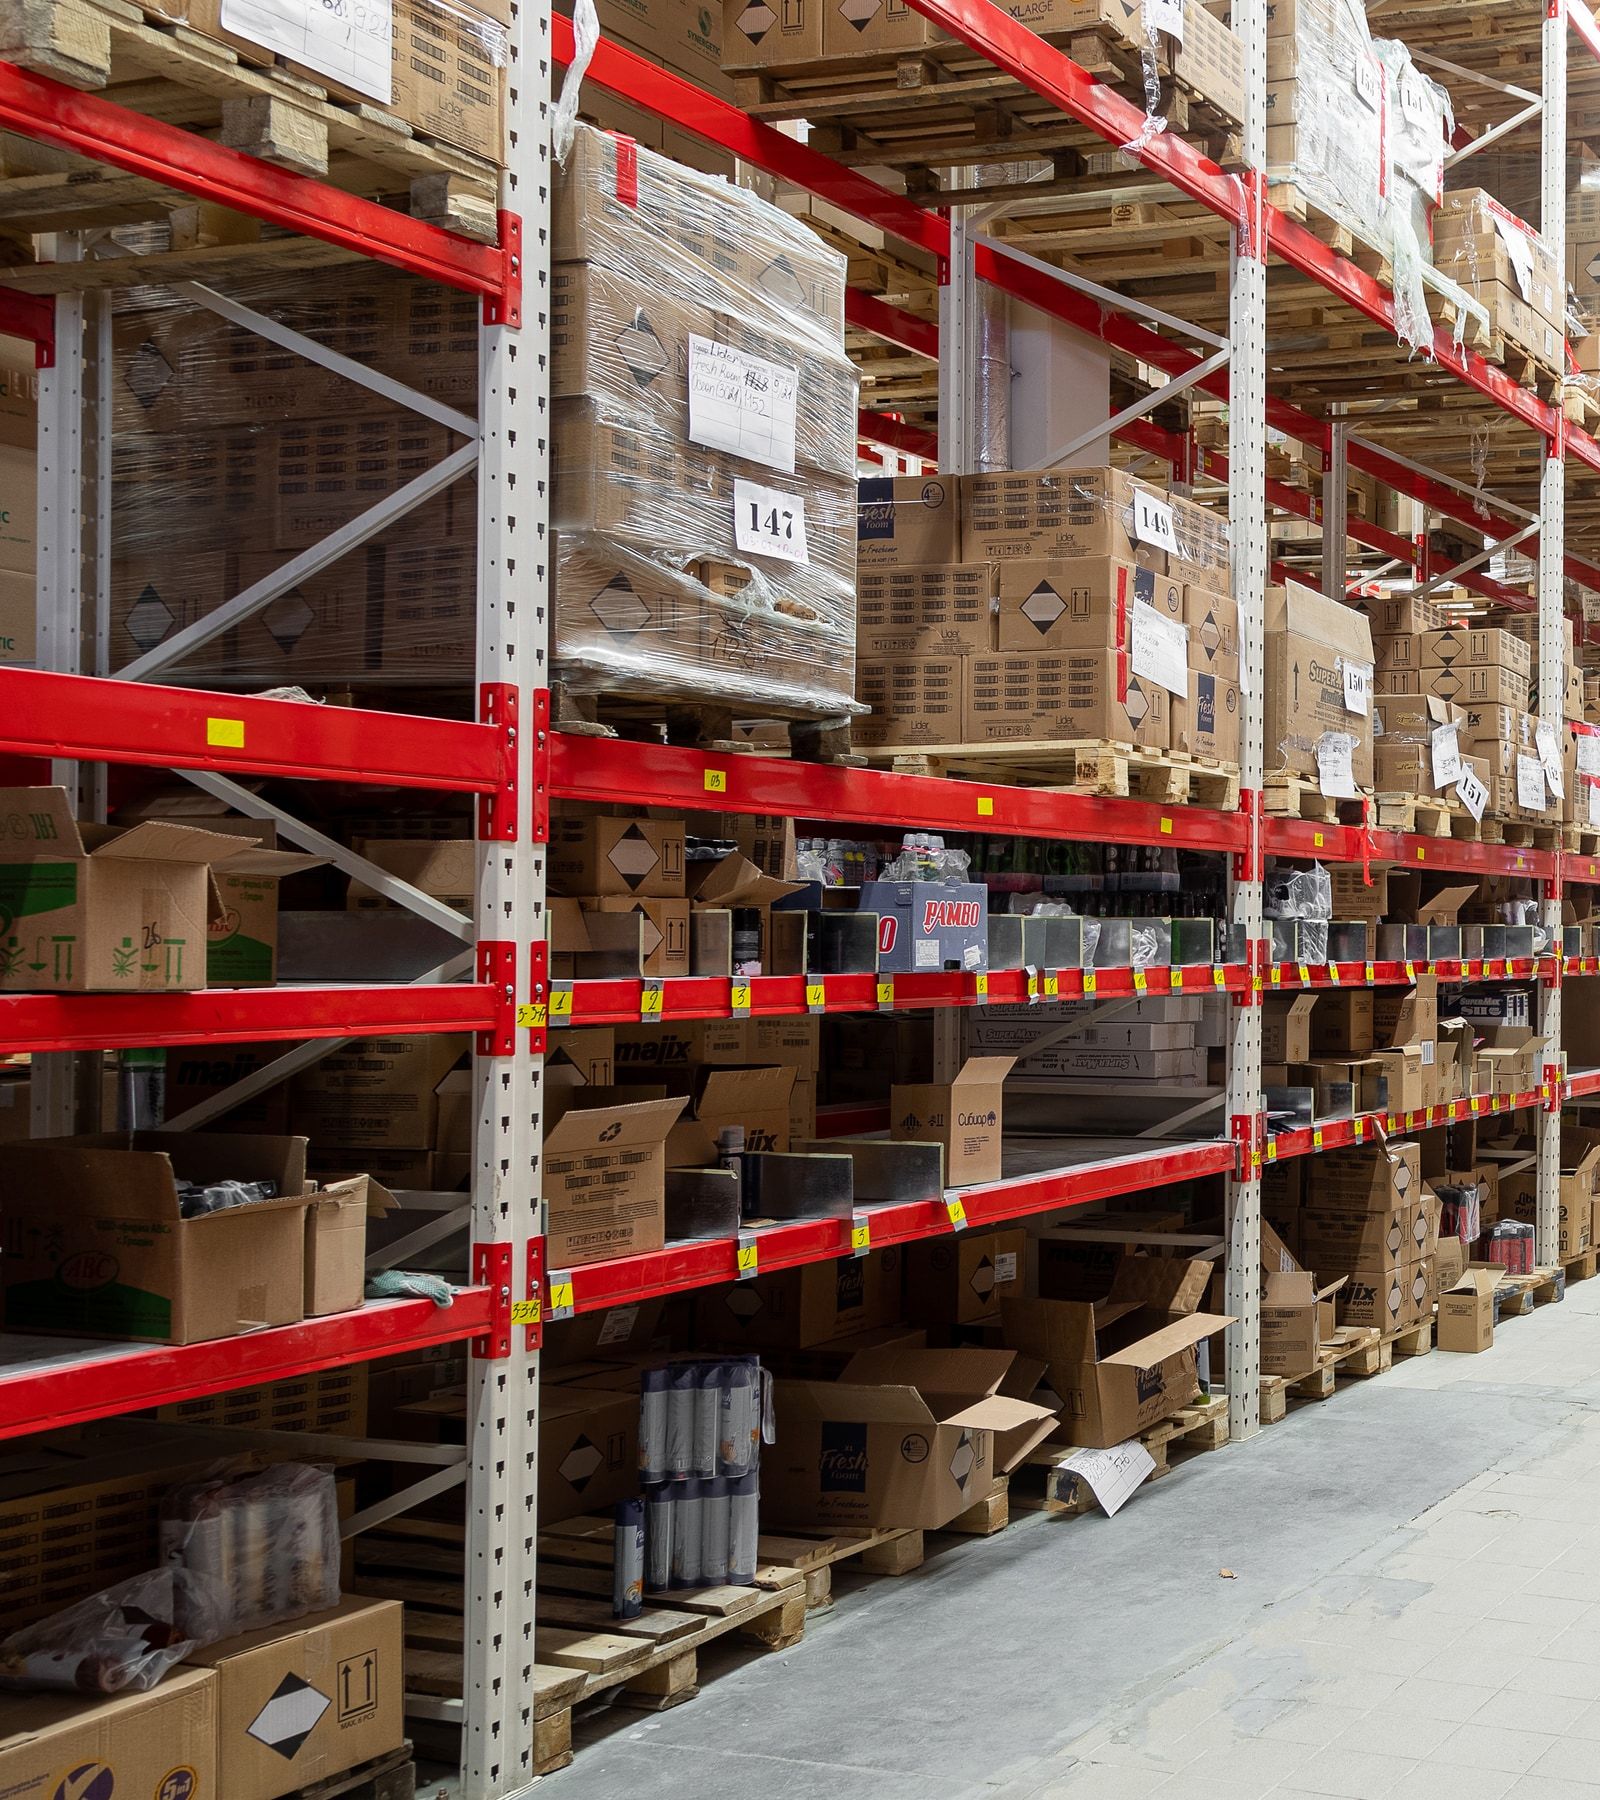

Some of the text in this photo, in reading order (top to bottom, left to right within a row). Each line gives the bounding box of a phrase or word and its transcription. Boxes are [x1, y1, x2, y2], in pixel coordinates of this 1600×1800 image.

[1008, 2, 1054, 18] XLARGE
[687, 29, 721, 57] SYNERGETIC
[750, 502, 794, 540] 147
[1143, 506, 1169, 537] 149
[1055, 533, 1075, 542] Lider
[941, 629, 960, 638] Lider
[1348, 672, 1364, 693] 150
[1198, 696, 1216, 715] Fresh
[911, 720, 929, 730] Lider
[1056, 715, 1075, 725] Lider
[1463, 777, 1482, 807] 151
[979, 977, 985, 991] 6
[1049, 978, 1057, 993] 8
[1086, 975, 1093, 989] 9
[556, 992, 565, 1010] 1
[648, 985, 659, 1012] 2
[736, 983, 747, 1006] 3
[812, 988, 821, 1001] 4
[882, 984, 891, 1000] 5
[615, 1035, 692, 1063] majix
[176, 1053, 258, 1086] maji
[952, 1206, 962, 1220] 4
[858, 1229, 866, 1245] 3
[743, 1249, 753, 1266] 2
[556, 1284, 565, 1308] 1
[819, 1449, 868, 1471] Fresh
[340, 1719, 357, 1730] MAX.
[364, 1712, 376, 1723] PCS
